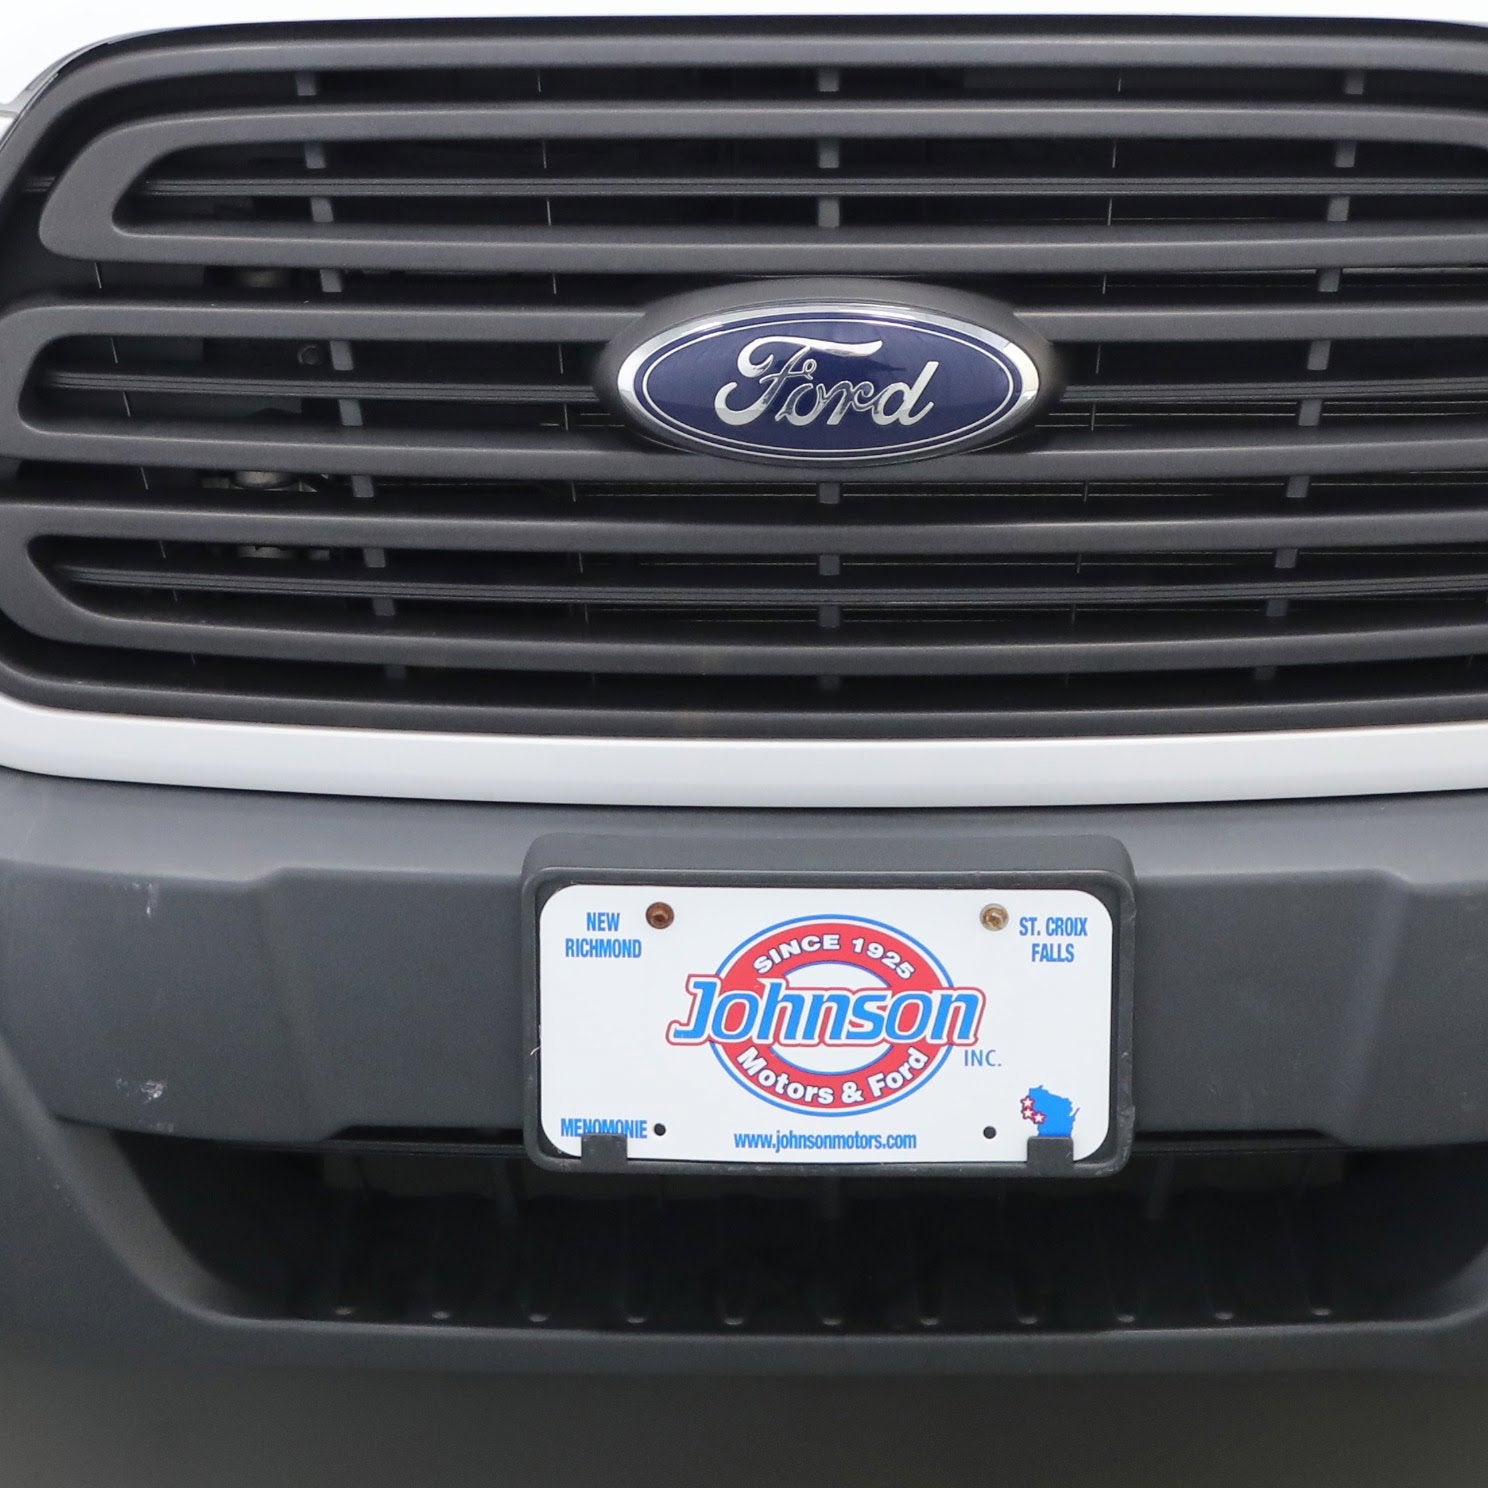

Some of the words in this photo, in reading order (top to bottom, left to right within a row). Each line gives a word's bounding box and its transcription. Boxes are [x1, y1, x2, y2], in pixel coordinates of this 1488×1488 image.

[715, 335, 939, 426] Ford
[586, 912, 620, 932] NEW
[1019, 917, 1041, 936] ST.
[1046, 917, 1088, 936] CROIX
[565, 938, 642, 958] RICHMOND
[753, 934, 841, 975] SINCE
[851, 938, 915, 979] 1925
[1031, 943, 1075, 963] FALLS
[670, 977, 982, 1044] Johnson
[964, 1049, 1002, 1068] INC.
[736, 1047, 834, 1105] Motors
[841, 1081, 864, 1105] &
[868, 1047, 929, 1098] Ford
[560, 1118, 648, 1139] MENOMONIE
[733, 1131, 917, 1153] www.johnsonmotors.com
